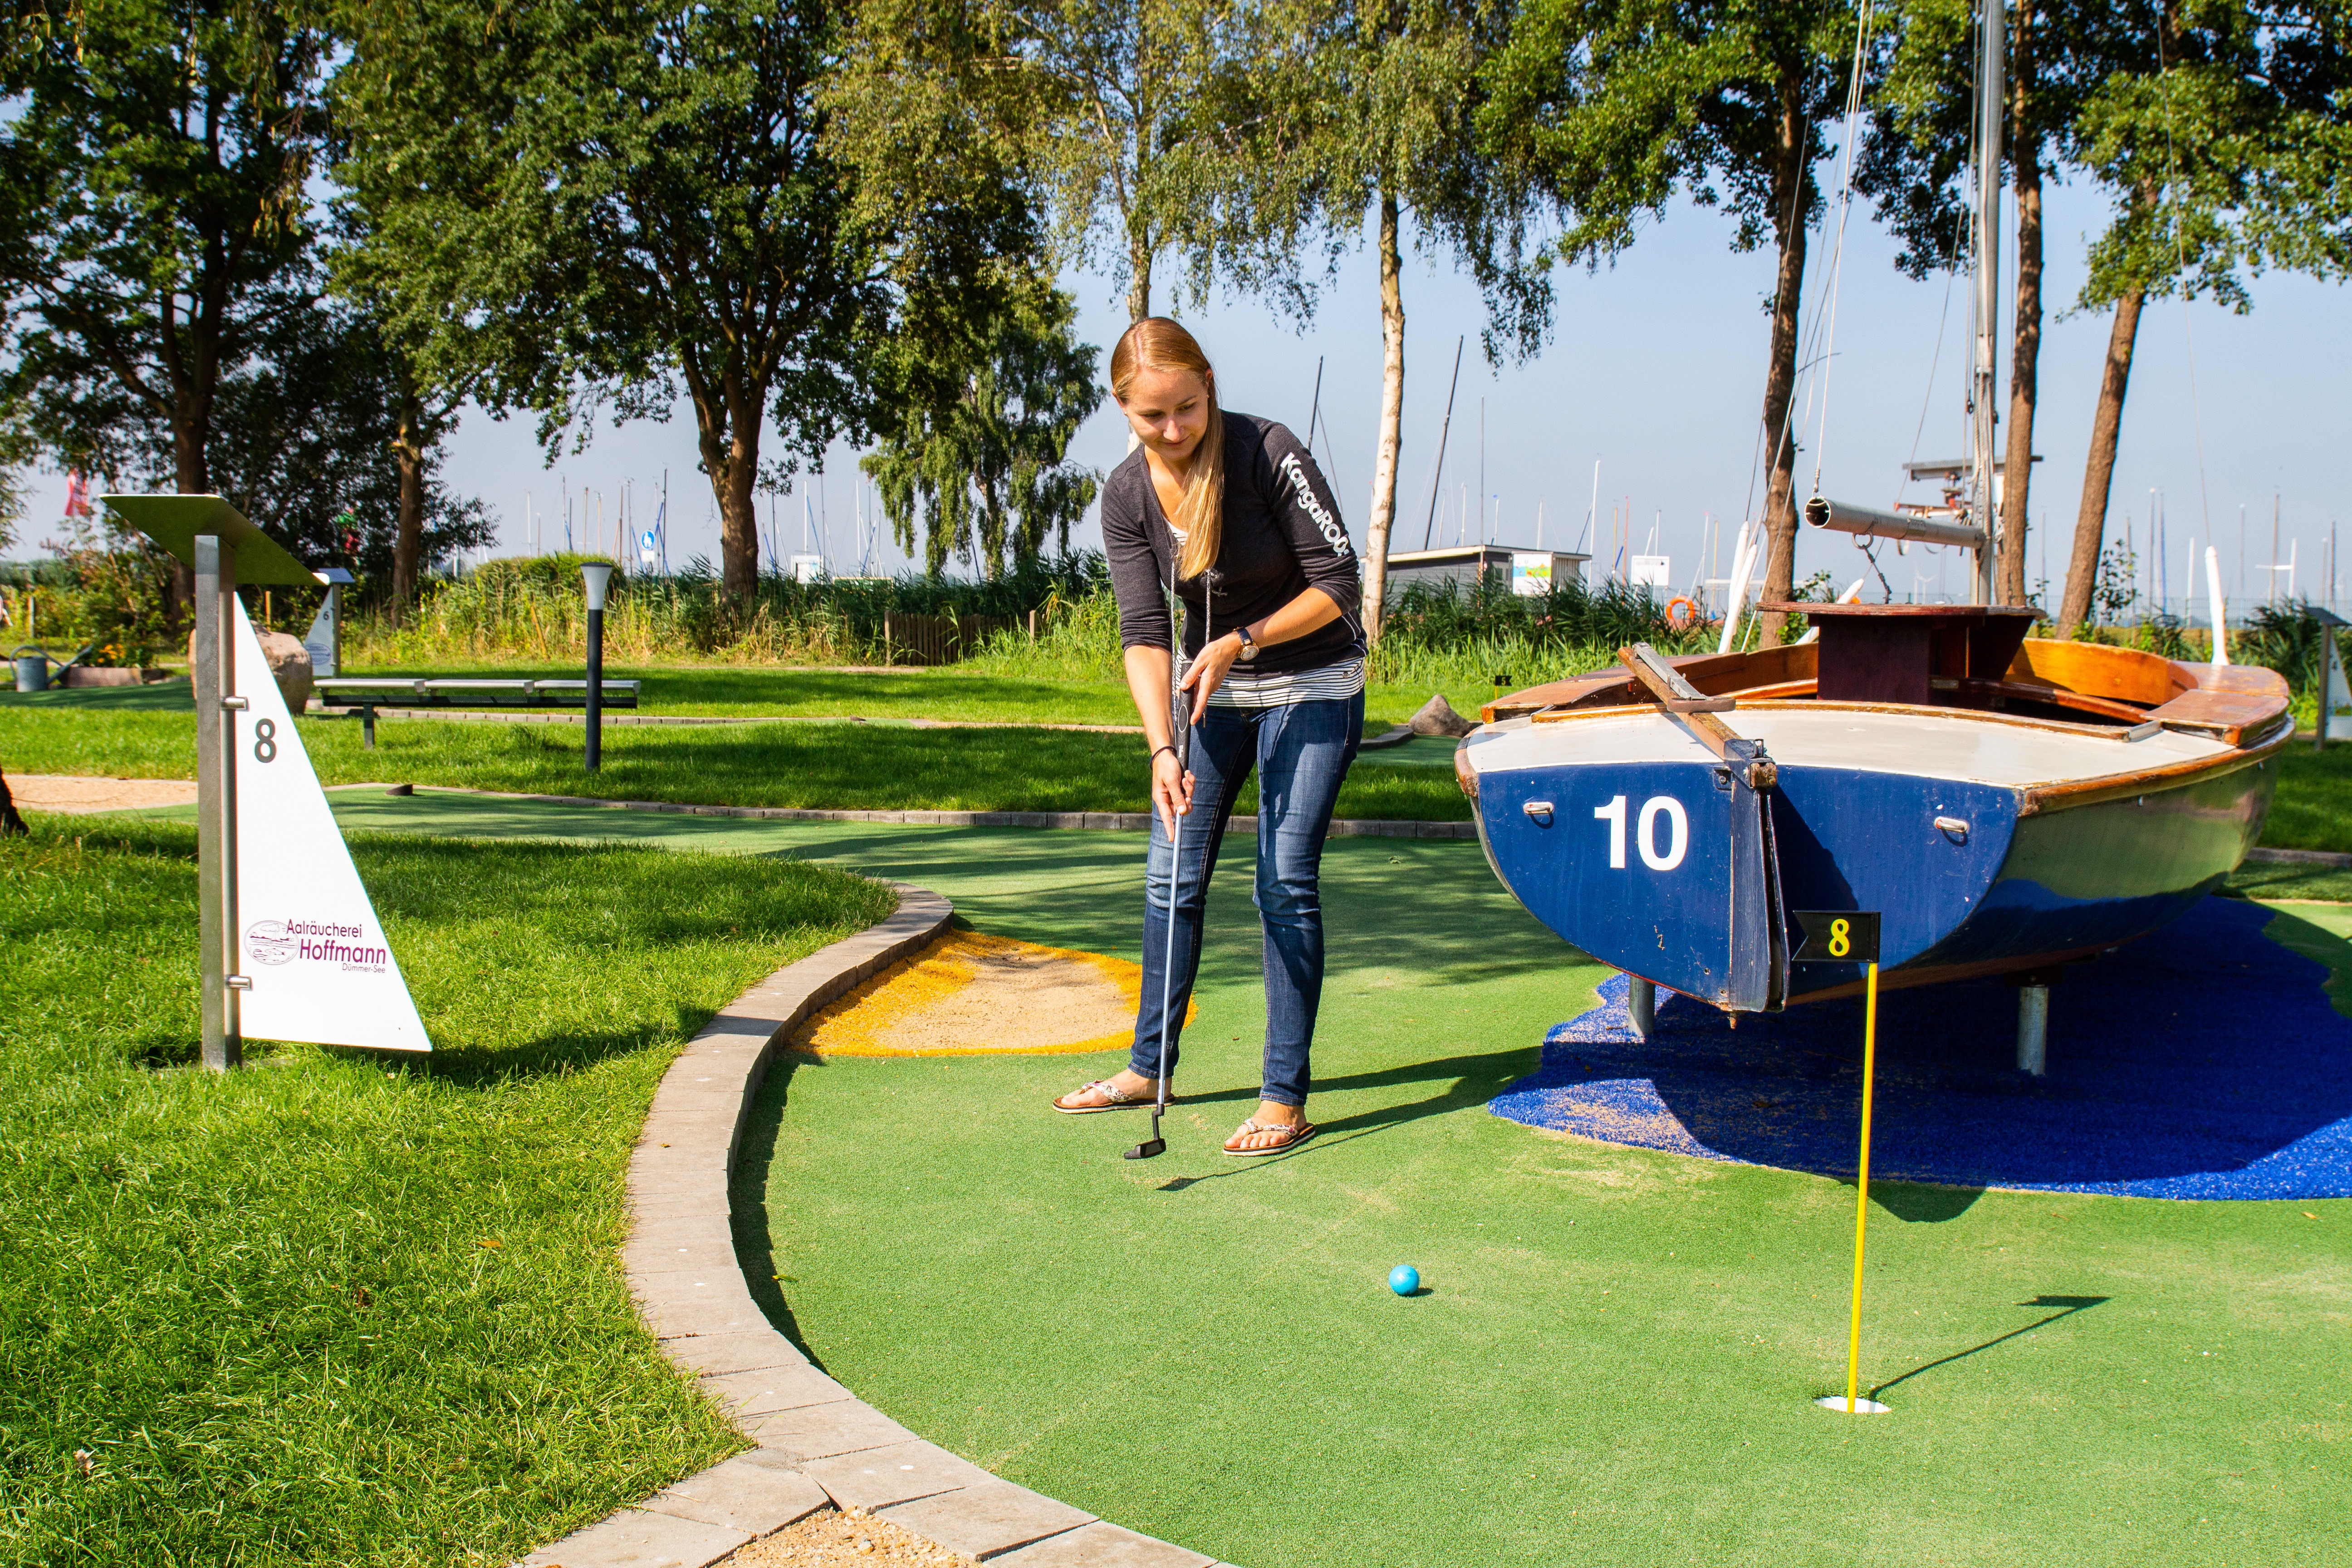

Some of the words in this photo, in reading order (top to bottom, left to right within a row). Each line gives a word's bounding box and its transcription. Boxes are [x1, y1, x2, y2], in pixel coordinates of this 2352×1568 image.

[323, 611, 329, 620] 6
[1501, 677, 1506, 686] 5
[255, 718, 277, 763] 8
[1594, 795, 1688, 871] 10
[287, 919, 362, 937] Aalräucherei
[1828, 918, 1850, 956] 8
[300, 939, 386, 964] Hoffmann
[342, 963, 385, 973] Dümmer-See
